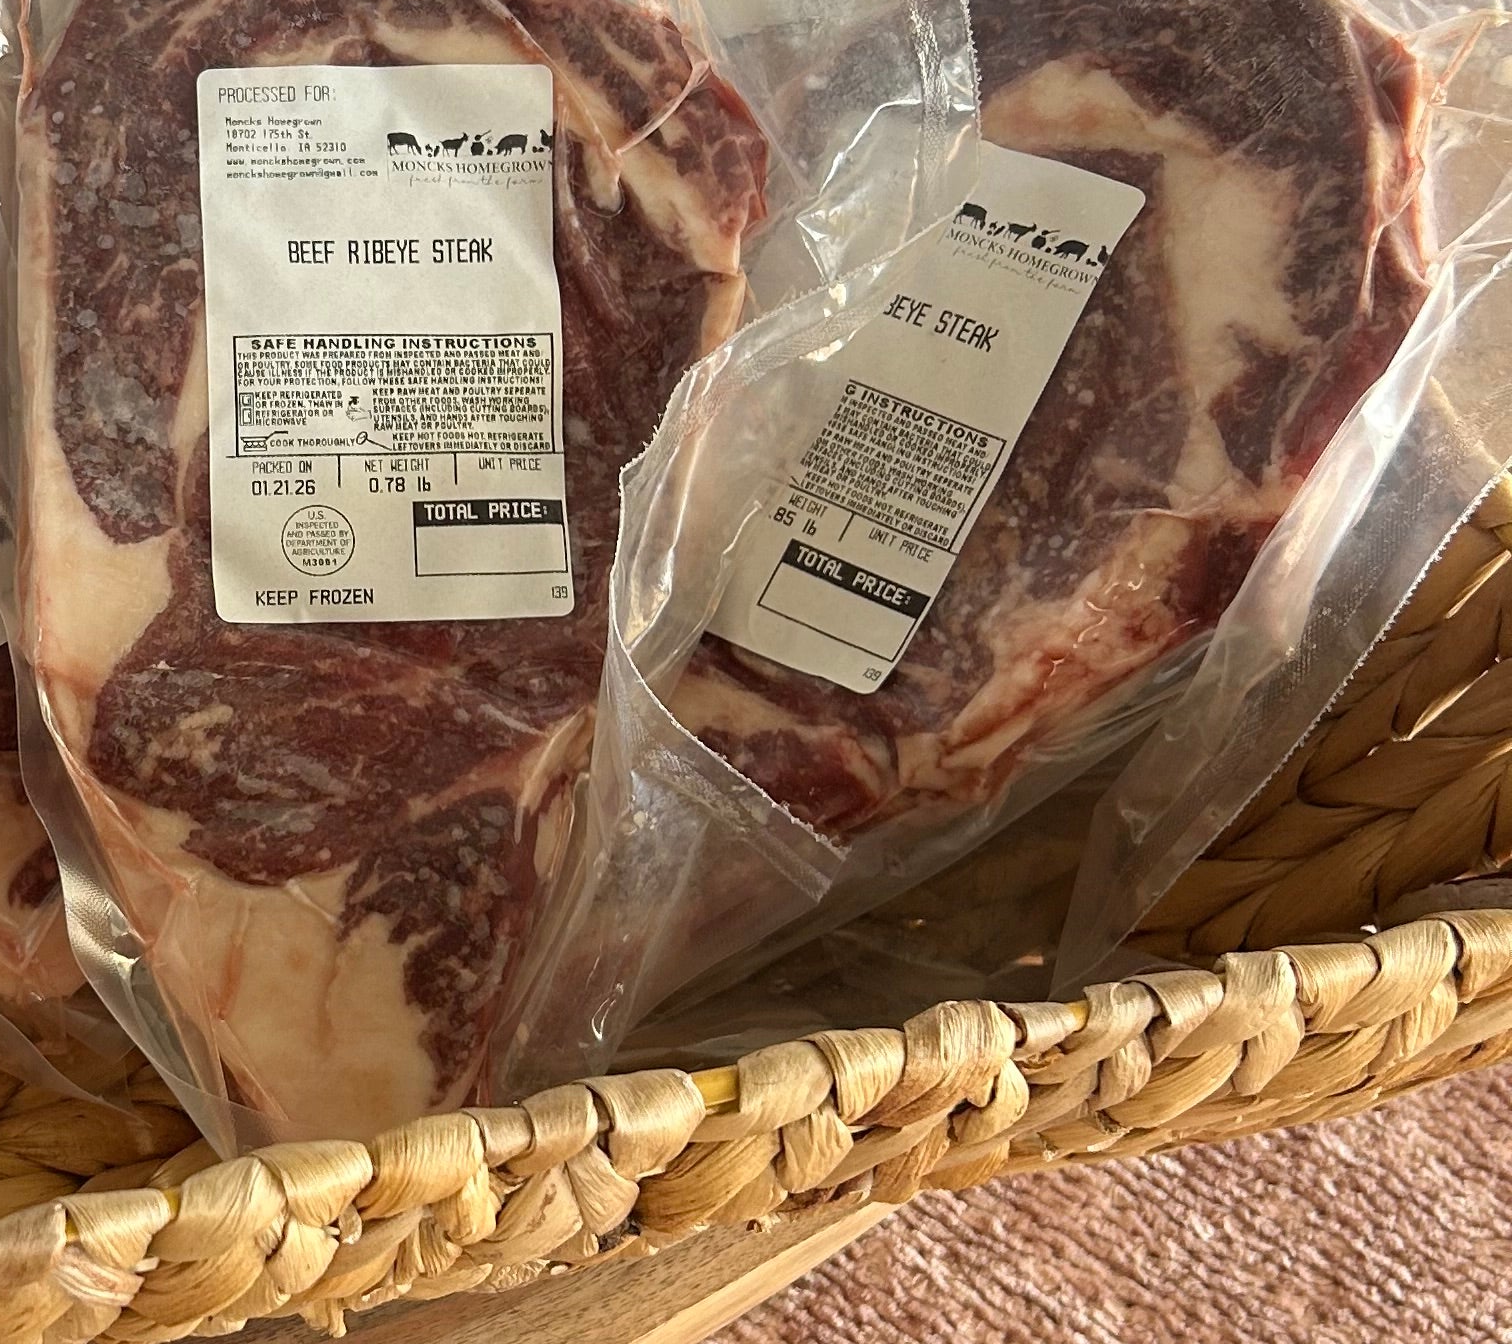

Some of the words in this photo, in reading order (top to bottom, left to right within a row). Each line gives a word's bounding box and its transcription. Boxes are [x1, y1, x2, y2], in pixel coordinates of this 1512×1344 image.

[218, 85, 296, 103] PROCESSED
[304, 85, 336, 102] FOR:
[225, 116, 261, 126] Moncks
[267, 116, 322, 127] Homegrown
[226, 129, 256, 138] 18702
[263, 129, 292, 138] 175th
[298, 142, 310, 152] IA
[316, 142, 347, 152] 52310
[392, 160, 452, 173] MONCKS
[944, 226, 1007, 257] MONCKS
[288, 239, 335, 265] BEEF
[348, 238, 419, 265] RIBEYE
[432, 237, 492, 264] STEAK
[931, 309, 1001, 352] STEAK
[251, 338, 296, 350] SAFE
[303, 337, 395, 350] HANDLING
[402, 337, 536, 349] INSTRUCTIONS
[237, 351, 256, 360] THIS
[259, 350, 299, 360] PRODUCT
[302, 350, 320, 359] WAS
[322, 350, 365, 359] PREPARED
[368, 350, 388, 358] FROM
[394, 350, 441, 358] INSPECTED
[443, 349, 461, 358] AND
[463, 349, 495, 358] PASSED
[497, 349, 520, 357] MEAT
[522, 349, 540, 357] AND
[237, 377, 254, 386] FOR
[258, 377, 281, 386] YOUR
[341, 377, 375, 386] FOLLOW
[378, 377, 404, 386] THESE
[407, 377, 427, 386] SAFE
[431, 376, 474, 386] HANDLING
[255, 391, 276, 399] KEEP
[372, 386, 394, 395] KEEP
[397, 386, 416, 395] RAW
[418, 386, 440, 395] MEAT
[442, 386, 460, 395] AND
[463, 386, 502, 395] POULTRY
[859, 389, 991, 449] INSTRUCTIONS
[269, 438, 294, 447] COOK
[297, 438, 354, 447] THOROUGHLY
[252, 460, 292, 474] PACKED
[298, 460, 312, 473] ON
[364, 458, 382, 472] NET
[390, 457, 429, 472] WEIGHT
[478, 457, 503, 470] UNIT
[509, 457, 541, 471] PRICE
[251, 479, 315, 496] 01.21.26
[369, 476, 405, 493] 0.78
[417, 476, 431, 492] lb
[423, 502, 478, 521] TOTAL
[488, 501, 547, 520] PRICE:
[787, 492, 829, 518] WEIGHT
[307, 510, 325, 520] U.S.
[295, 521, 338, 529] INSPECTED
[801, 518, 820, 536] lb
[286, 530, 303, 538] AND
[306, 530, 336, 538] PASSED
[338, 530, 349, 538] BY
[285, 538, 337, 547] DEPARTMENT
[339, 538, 351, 547] OF
[866, 526, 897, 549] UNIT
[897, 538, 934, 563] PRICE
[291, 547, 345, 555] AGRICULTURE
[792, 545, 849, 581] TOTAL
[851, 570, 914, 608] PRICE:
[255, 589, 298, 605] KEEP
[309, 588, 374, 605] FROZEN
[551, 585, 568, 599] 139
[861, 666, 882, 682] 139
